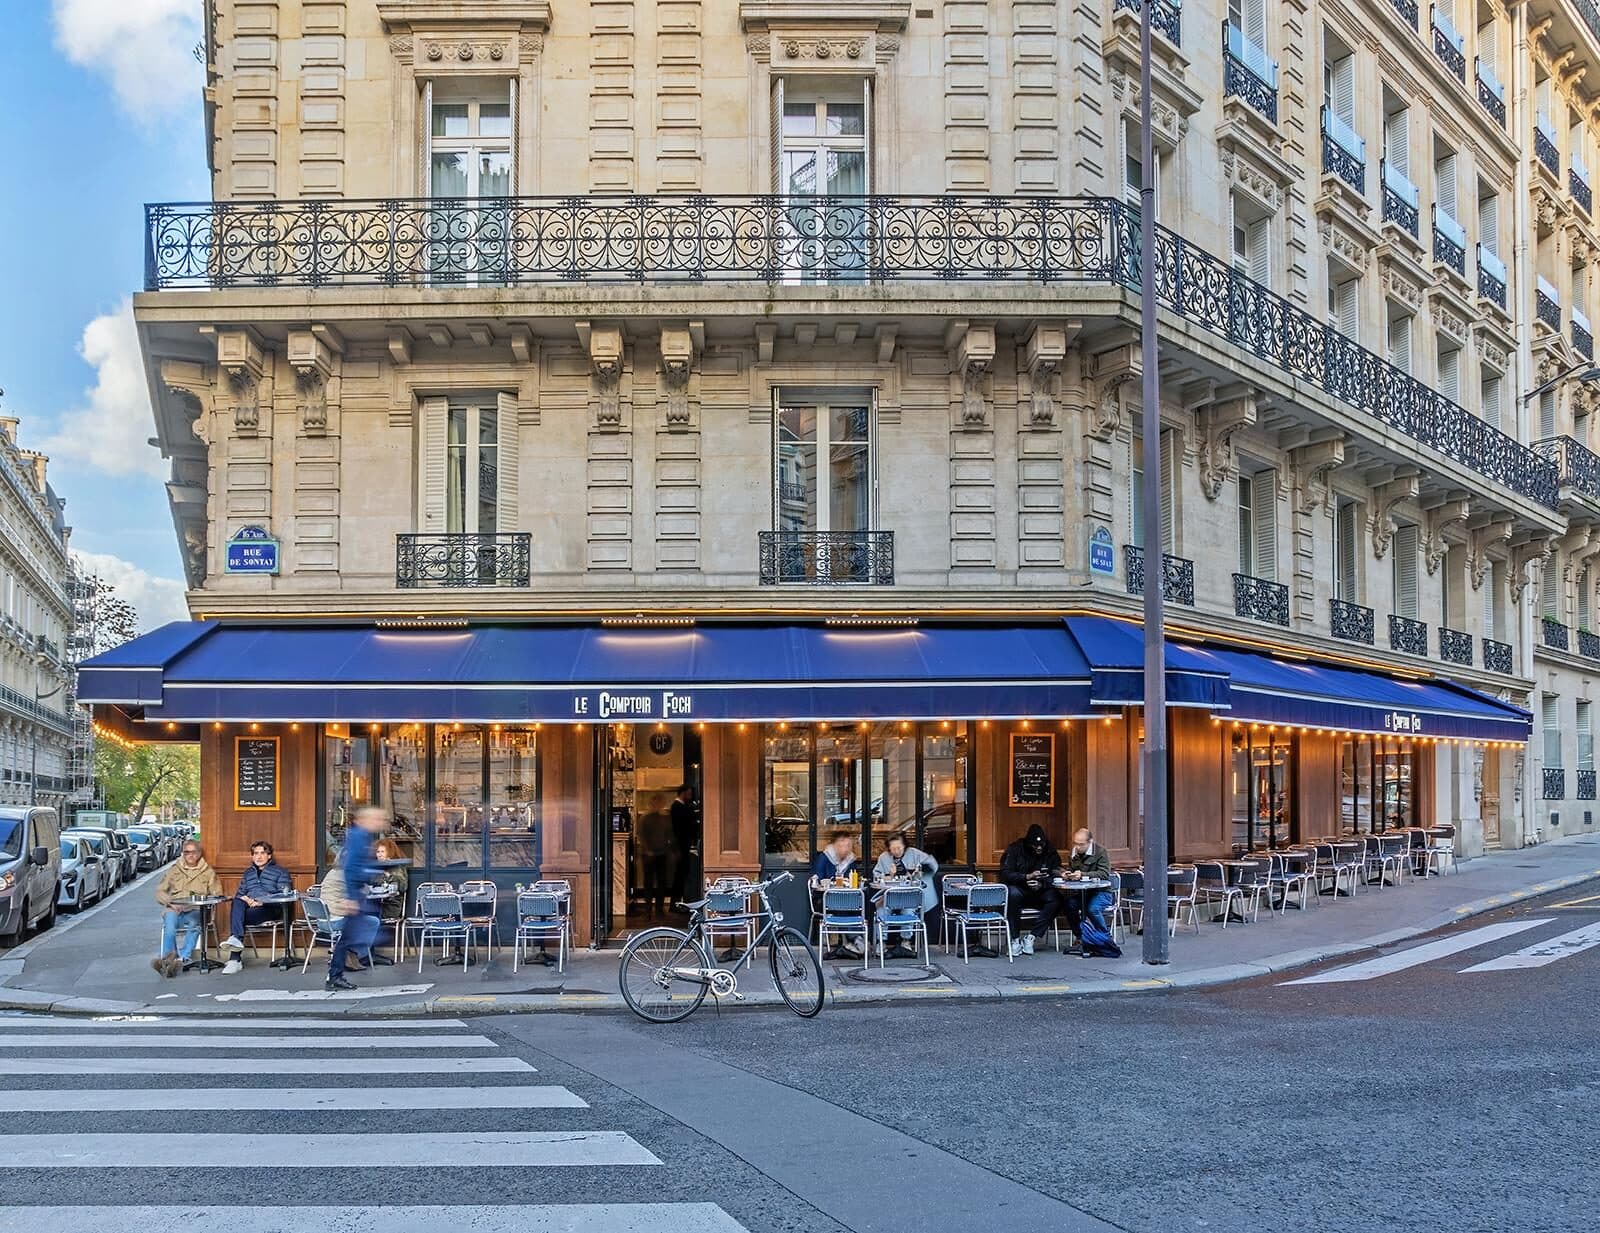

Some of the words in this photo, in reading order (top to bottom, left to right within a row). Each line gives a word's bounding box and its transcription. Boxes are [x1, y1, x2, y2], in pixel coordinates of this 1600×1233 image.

[243, 548, 262, 557] RUE
[229, 558, 241, 566] DE
[242, 558, 274, 567] SONTAY
[574, 696, 588, 714] LE
[599, 691, 652, 718] COMPTOIR
[662, 691, 691, 718] FOCH
[655, 736, 668, 750] CF
